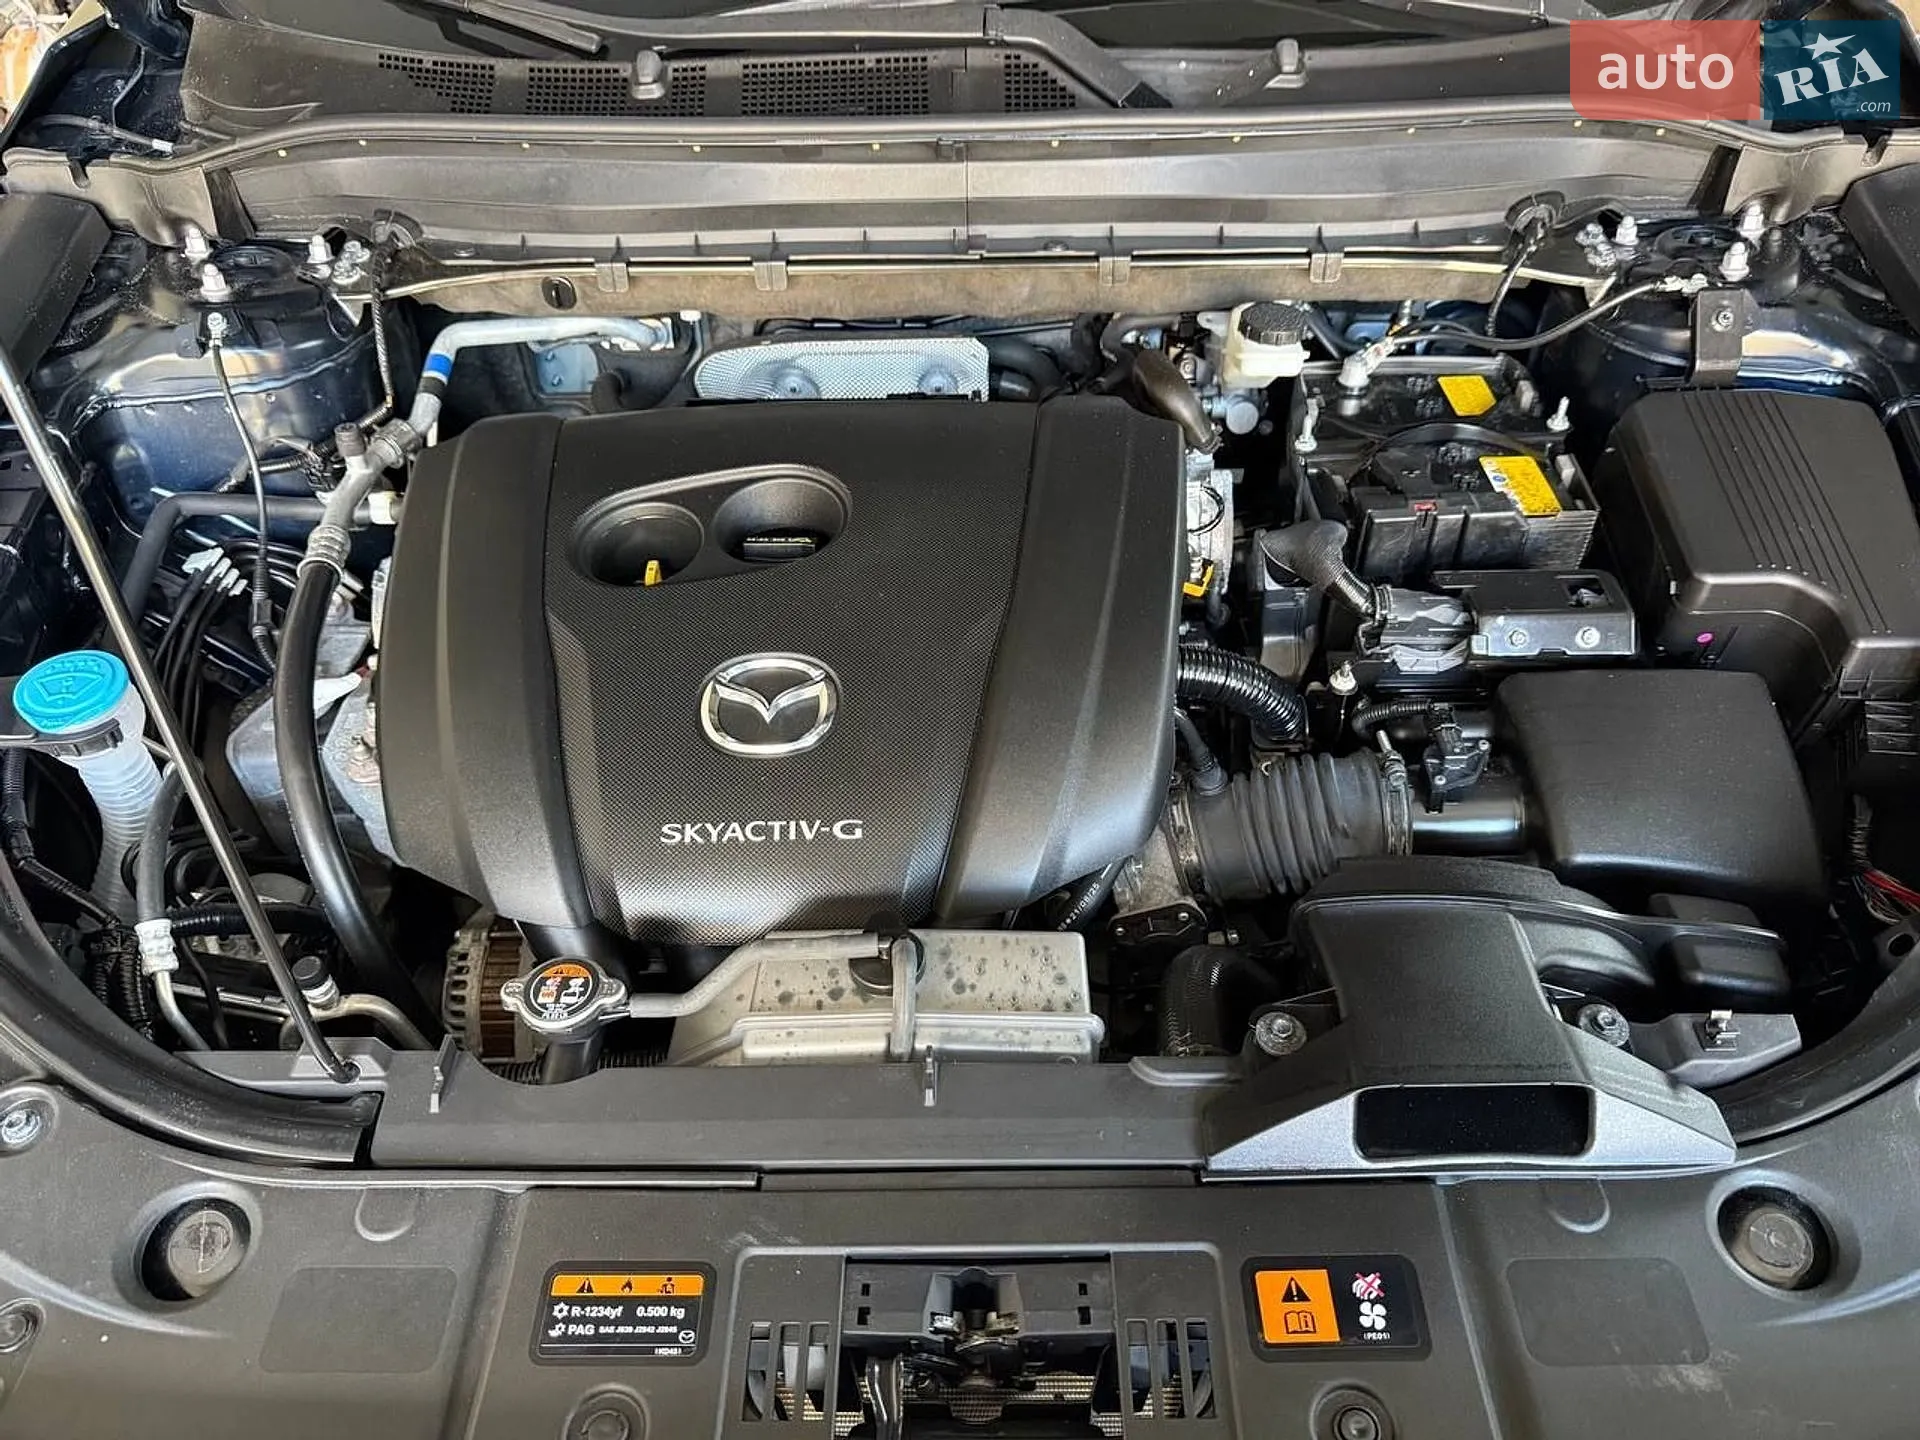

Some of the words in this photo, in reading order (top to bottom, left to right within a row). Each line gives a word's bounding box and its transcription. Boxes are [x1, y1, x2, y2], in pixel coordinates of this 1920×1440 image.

[660, 819, 864, 844] SKYACTIV-G
[571, 1305, 624, 1319] R-1234yf
[636, 1306, 668, 1317] 0.500
[670, 1305, 685, 1319] kg
[568, 1323, 596, 1335] PAG
